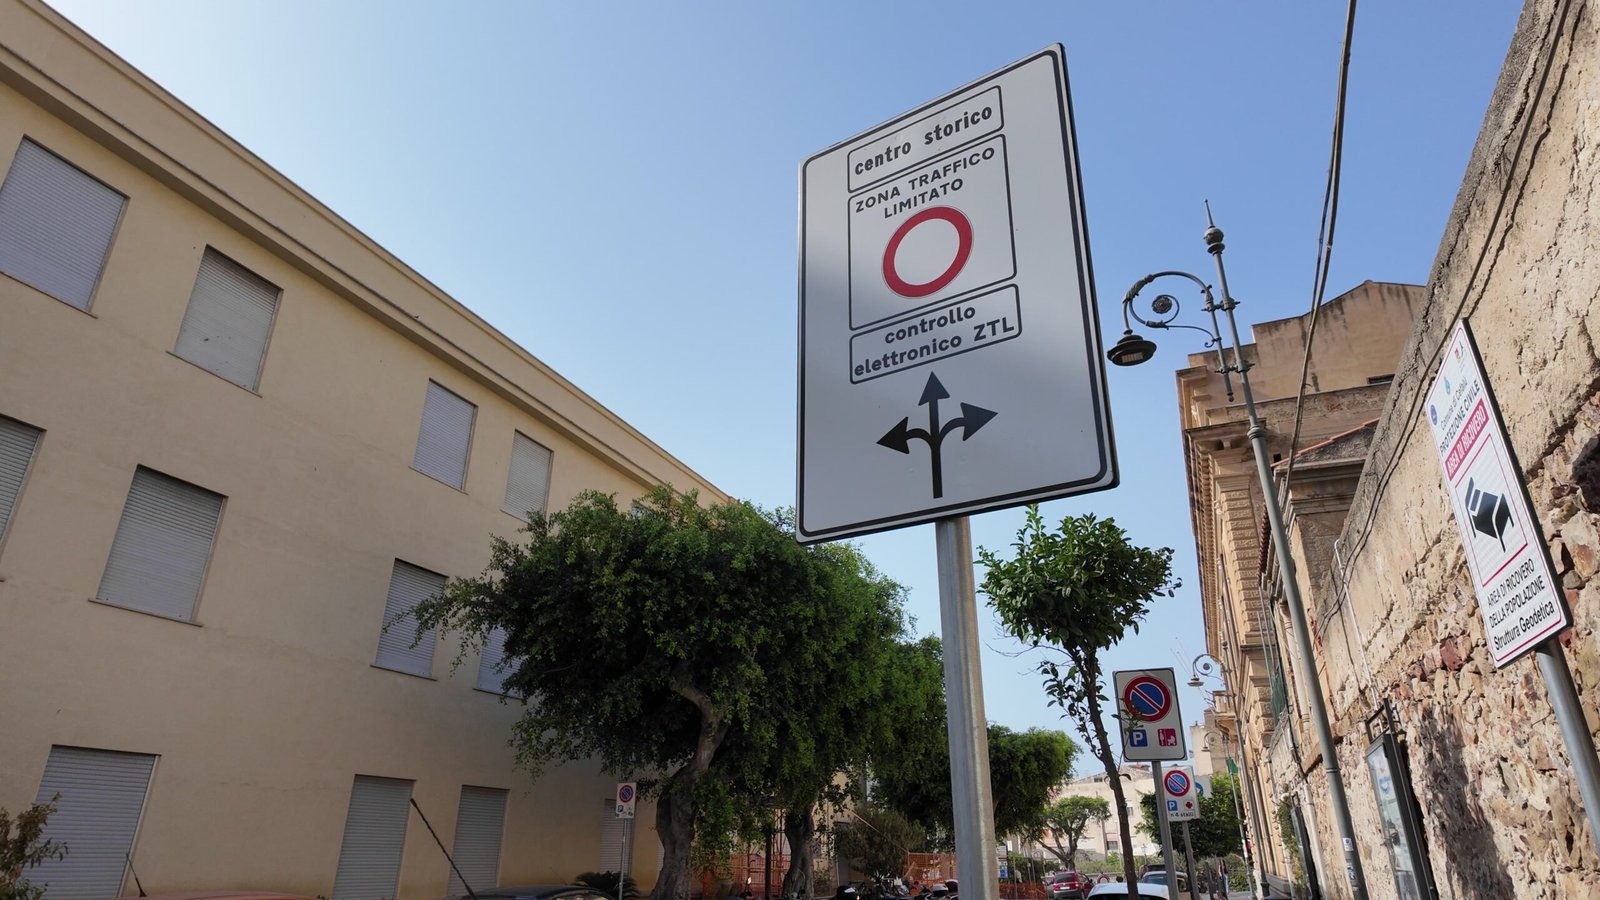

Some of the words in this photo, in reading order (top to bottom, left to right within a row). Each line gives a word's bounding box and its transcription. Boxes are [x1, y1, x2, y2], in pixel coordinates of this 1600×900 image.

[854, 141, 912, 175] centro
[924, 106, 993, 145] storico
[855, 186, 901, 213] ZONA
[908, 147, 995, 190] TRAFFICO
[884, 178, 963, 218] LIMITATO
[854, 335, 962, 376] elettronico
[973, 316, 1015, 342] ZTL
[884, 306, 976, 343] controllo
[1439, 406, 1466, 457] PROTEZIONE
[1463, 379, 1481, 412] CIVILE
[1447, 449, 1461, 477] AREA
[1456, 439, 1466, 460] DI
[1461, 404, 1487, 452] RICOVERO
[1487, 588, 1501, 608] AREA
[1500, 583, 1507, 598] DI
[1505, 558, 1535, 591] RICOVERO
[1489, 607, 1507, 629] DELLA
[1504, 575, 1546, 616] POPOLAZIONE
[1493, 625, 1521, 651] Struttura
[1519, 601, 1555, 633] Geodetica
[1133, 732, 1144, 745] P
